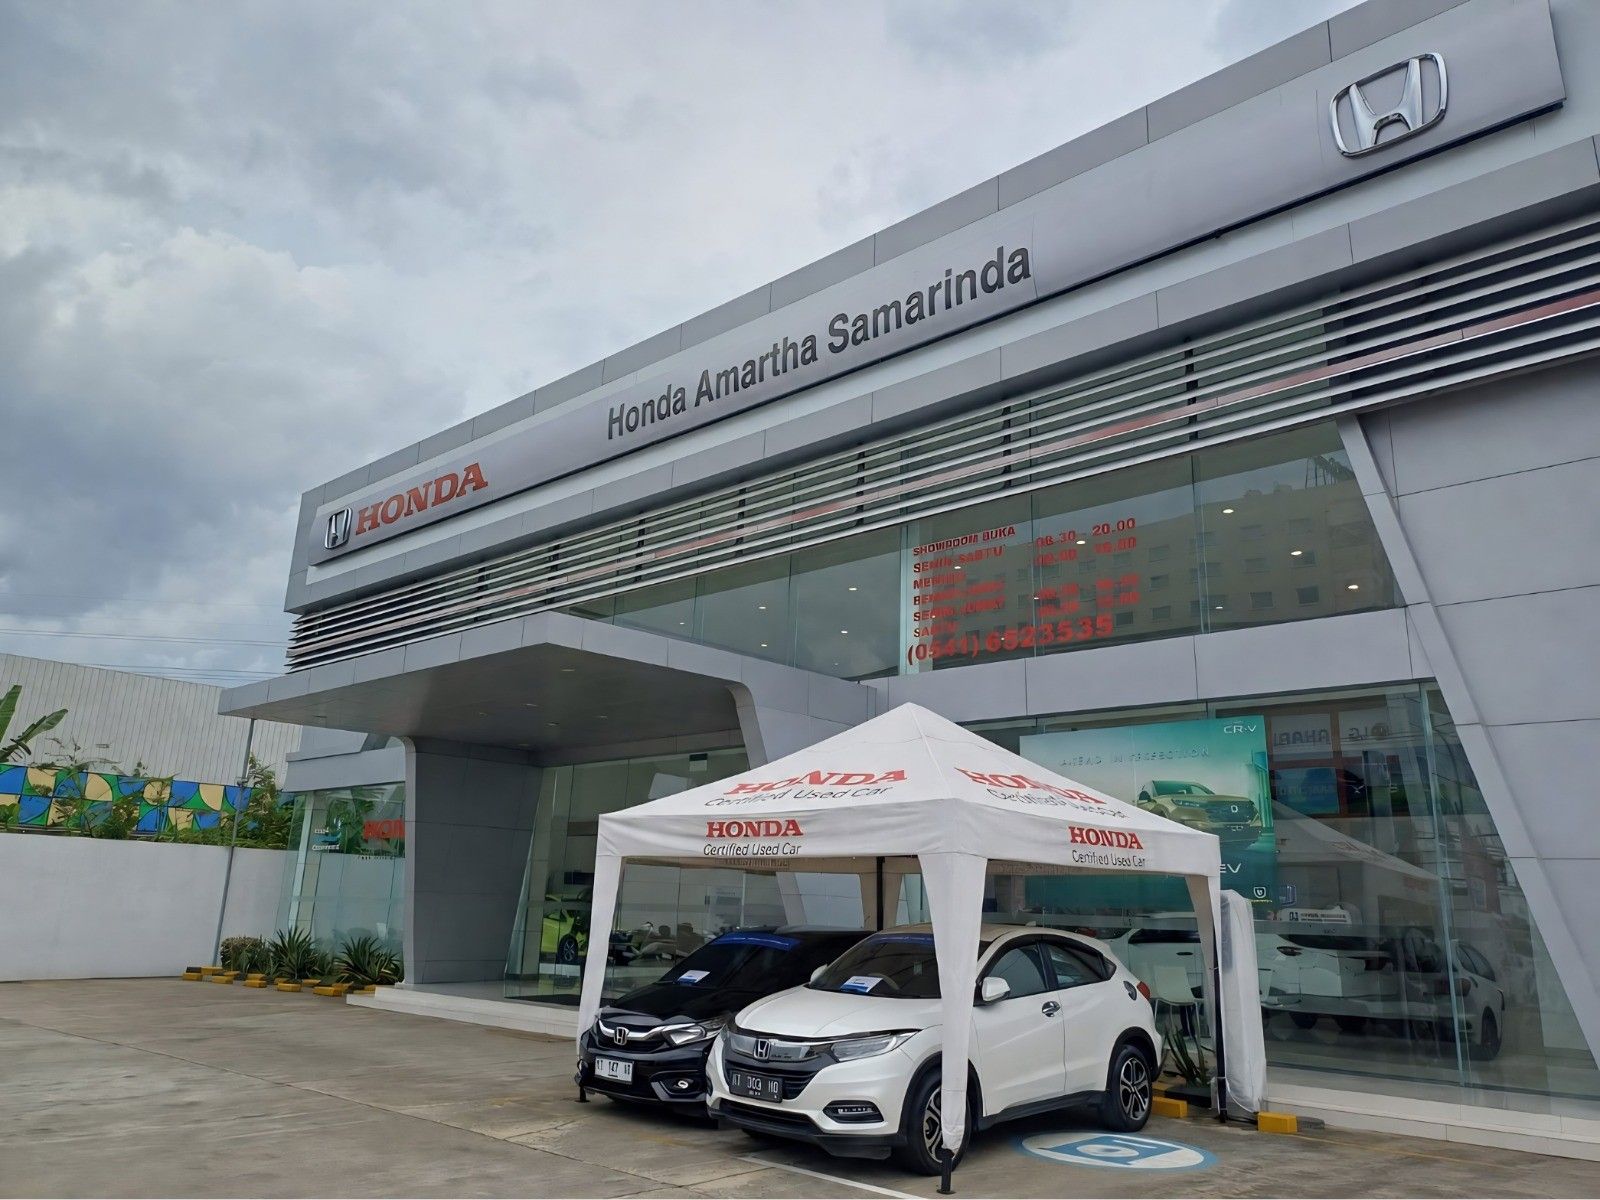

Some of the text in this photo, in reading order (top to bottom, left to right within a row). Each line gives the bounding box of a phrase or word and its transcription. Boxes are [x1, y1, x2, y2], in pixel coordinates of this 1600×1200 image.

[607, 246, 1031, 440] Honda Amartha Samarinda
[355, 462, 488, 535] HONDA
[1092, 518, 1136, 536] 20.00
[724, 769, 907, 795] HONDA
[794, 787, 848, 799] Used
[851, 786, 894, 795] Car
[954, 767, 1107, 804] HONDA
[706, 819, 804, 838] HONDA
[1068, 826, 1143, 849] HONDA
[704, 843, 802, 856] Certified Used Car
[1072, 850, 1146, 867] Certified Used Car
